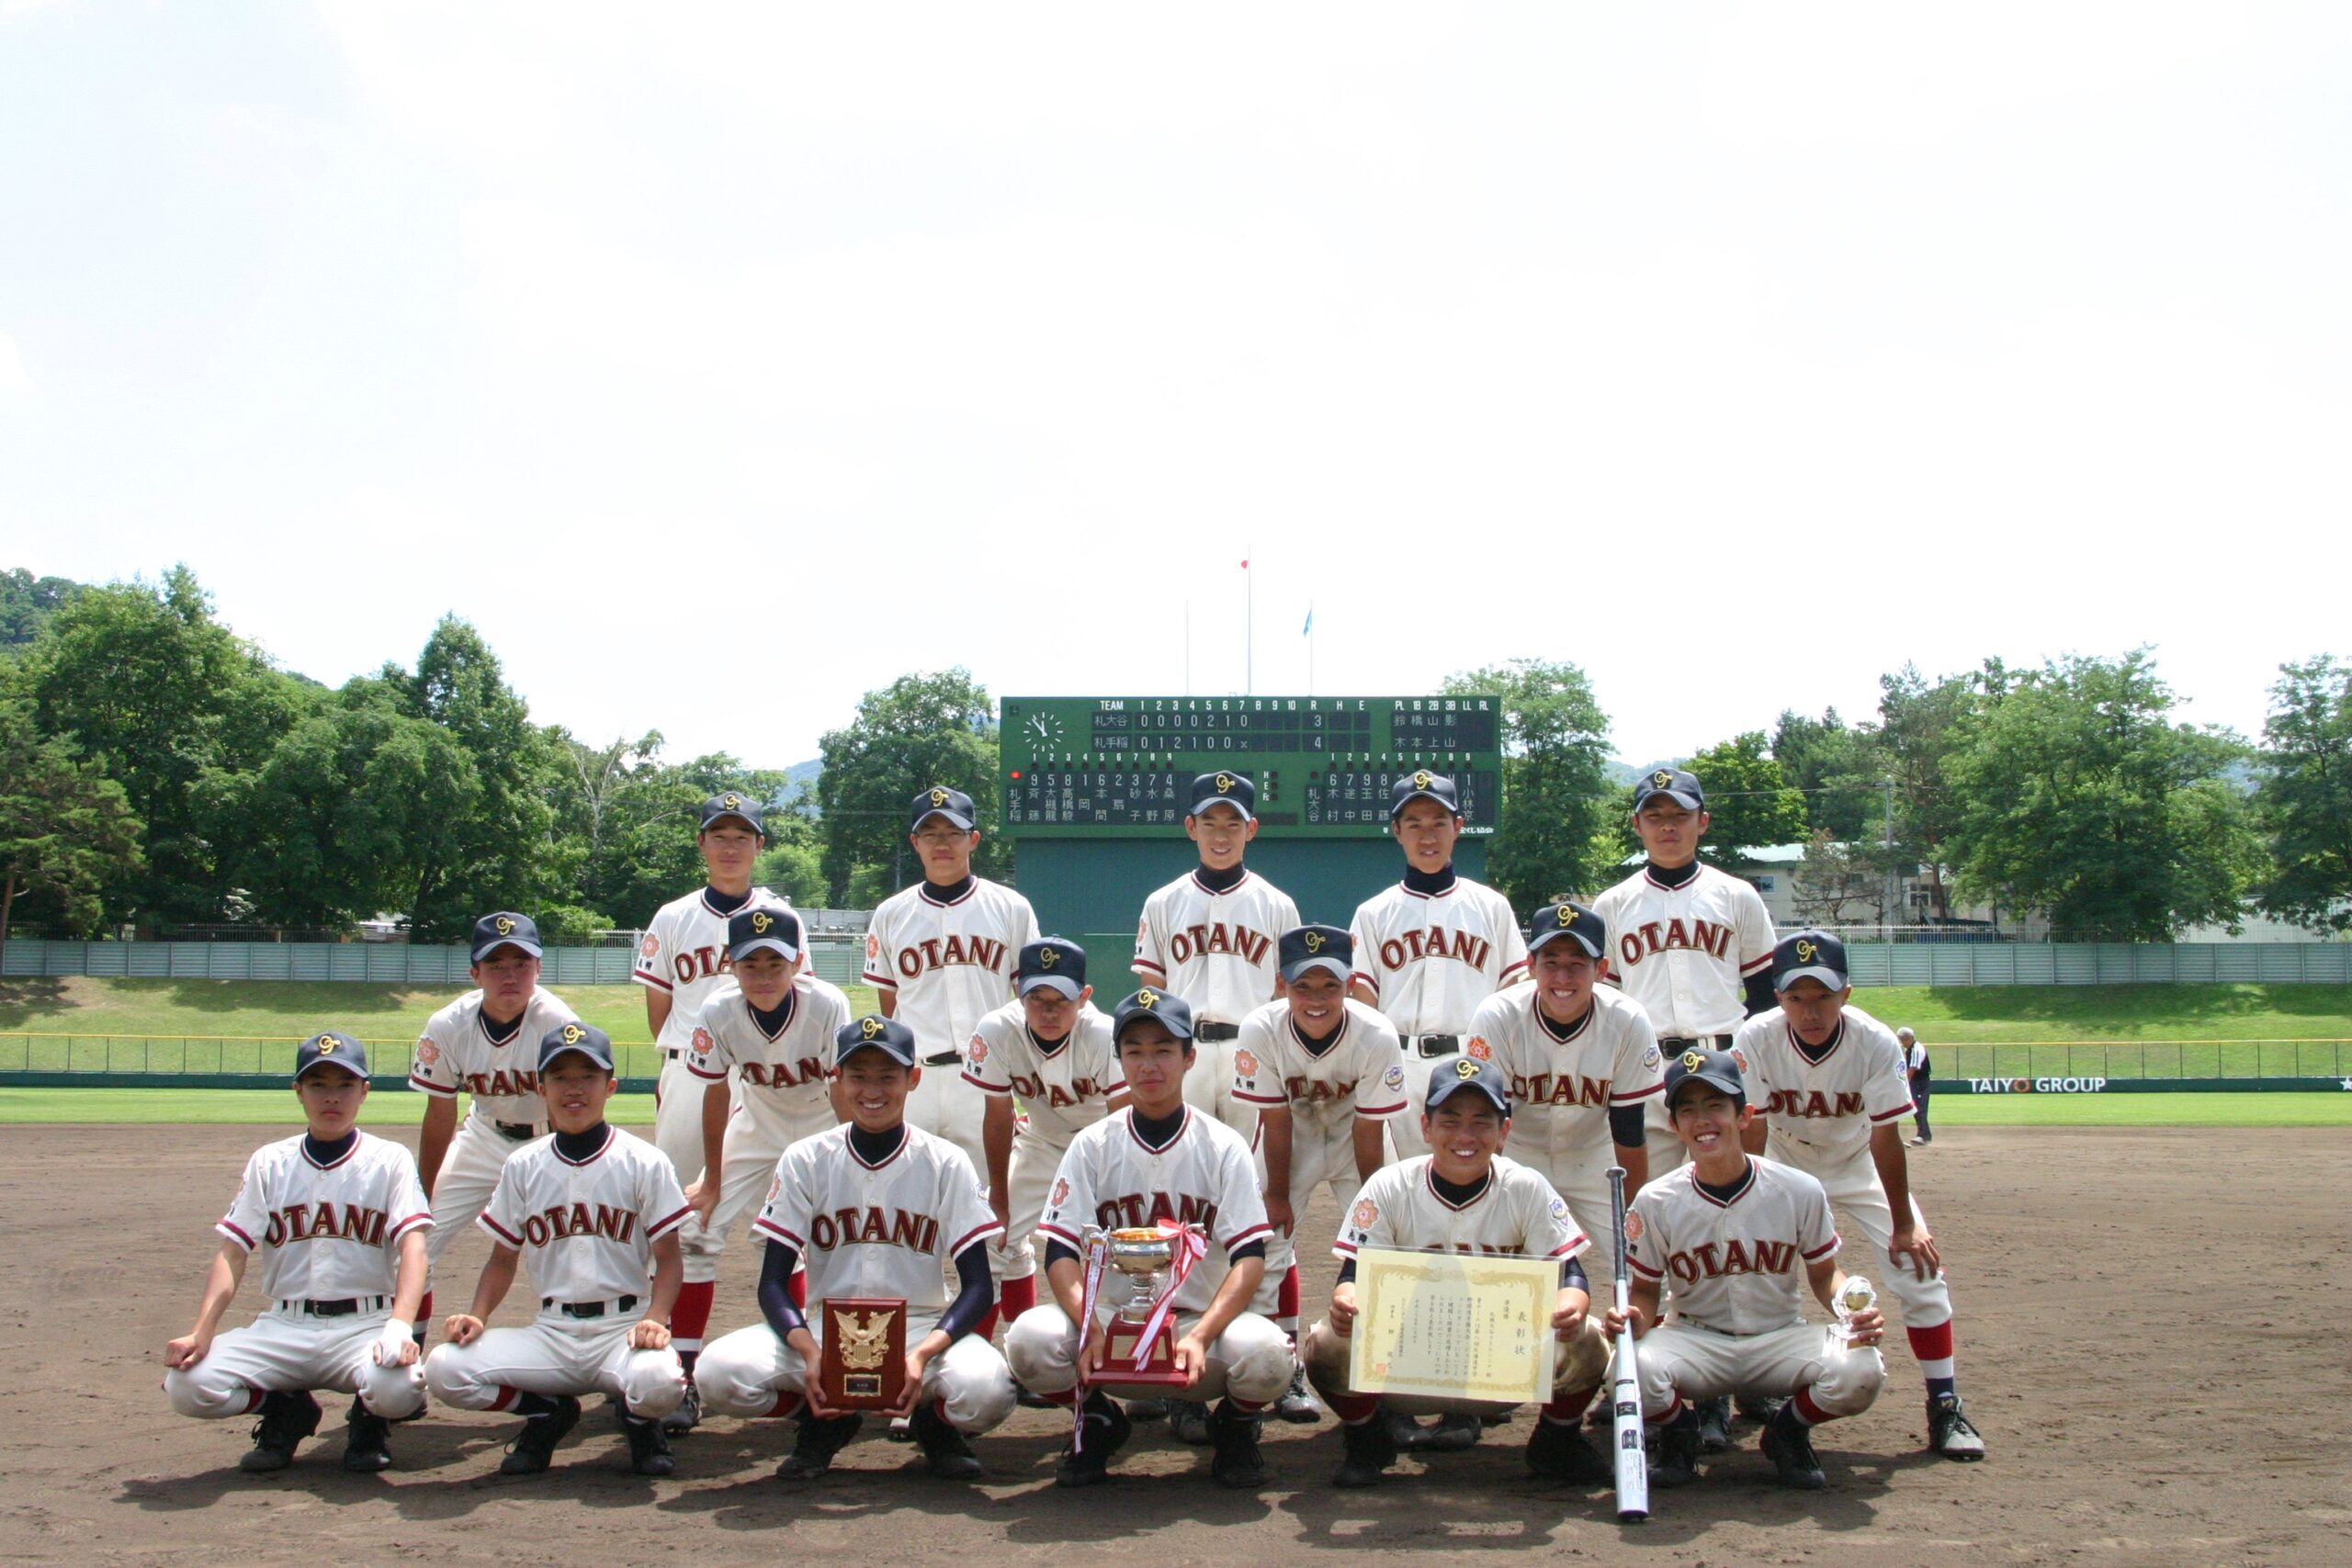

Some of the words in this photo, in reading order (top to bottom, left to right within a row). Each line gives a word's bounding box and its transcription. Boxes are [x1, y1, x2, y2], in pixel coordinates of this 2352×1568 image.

[1095, 715, 1127, 727] 札大谷
[1141, 715, 1148, 727] 0
[1158, 715, 1164, 727] 0
[1174, 715, 1181, 727] 0
[1191, 715, 1197, 727] 0
[1207, 715, 1214, 727] 2
[1227, 715, 1229, 727] 1
[1240, 715, 1248, 727] 0
[1315, 715, 1321, 727] 3
[1100, 700, 1124, 710] TEAM
[1141, 700, 1144, 710] 1
[1157, 700, 1161, 710] 2
[1173, 700, 1179, 710] 3
[1190, 700, 1194, 710] 4
[1206, 700, 1212, 710] 5
[1223, 700, 1227, 710] 6
[1239, 700, 1245, 710] 7
[1256, 700, 1261, 710] 8
[1272, 700, 1278, 710] 9
[1288, 700, 1295, 710] 10
[1311, 700, 1317, 710] R
[1337, 701, 1342, 710] H
[1359, 700, 1364, 710] E
[1395, 700, 1404, 710] PL
[1413, 700, 1420, 710] 1B
[1429, 700, 1439, 710] 2B
[1445, 701, 1455, 710] 3B
[1463, 701, 1472, 710] LL
[1479, 700, 1488, 710] RL
[1094, 737, 1127, 748] 札手稲
[1141, 737, 1148, 749] 0
[1159, 737, 1163, 749] 1
[1174, 737, 1181, 749] 2
[1193, 737, 1196, 749] 1
[1207, 737, 1214, 749] 0
[1224, 737, 1230, 749] 0
[1315, 737, 1321, 749] 4
[1394, 715, 1406, 748] 鈴木
[1411, 714, 1423, 748] 橋本
[1428, 716, 1440, 747] 山上
[1049, 753, 1054, 761] 2
[1100, 753, 1104, 761] 5
[1398, 752, 1403, 761] 5
[1432, 752, 1436, 761] 7
[1465, 752, 1470, 761] 9
[1031, 774, 1037, 786] 9
[1048, 774, 1055, 786] 5
[1065, 774, 1071, 786] 8
[1083, 774, 1087, 786] 1
[1099, 774, 1105, 785] 6
[1115, 774, 1122, 786] 2
[1132, 774, 1139, 785] 3
[1149, 774, 1156, 785] 7
[1166, 774, 1172, 785] 4
[1264, 771, 1269, 779] H
[1264, 782, 1268, 790] E
[1330, 773, 1337, 785] 6
[1347, 773, 1353, 785] 7
[1363, 773, 1370, 785] 9
[1381, 773, 1387, 785] 8
[1467, 774, 1470, 786] 1
[1010, 788, 1022, 821] 札手稲
[1079, 798, 1090, 810] 岡
[1096, 788, 1107, 821] 本間
[1129, 788, 1141, 821] 砂子
[1147, 788, 1159, 821] 水野
[1163, 788, 1175, 821] 桑原
[1308, 788, 1320, 822] 札大谷
[1328, 788, 1339, 821] 木村
[1361, 788, 1373, 821] 玉田
[1378, 788, 1389, 821] 佐藤
[899, 934, 1007, 979] OTANI
[1170, 922, 1272, 968] OTANI
[1381, 925, 1491, 973] OTANI
[1621, 919, 1736, 966] OTANI
[674, 944, 732, 984] OTA
[464, 1068, 537, 1096] TAN
[741, 1057, 825, 1089] TAN
[1285, 1076, 1357, 1101] TAN
[1968, 1077, 2031, 1093] TAIYO
[2035, 1077, 2106, 1093] GROUP
[1512, 1073, 1611, 1108] OTAN
[1768, 1089, 1864, 1119] OTAN
[265, 1201, 388, 1248] OTANI
[526, 1202, 639, 1247] OTANI
[811, 1206, 939, 1256] OTANI
[1669, 1240, 1797, 1285] OTANI
